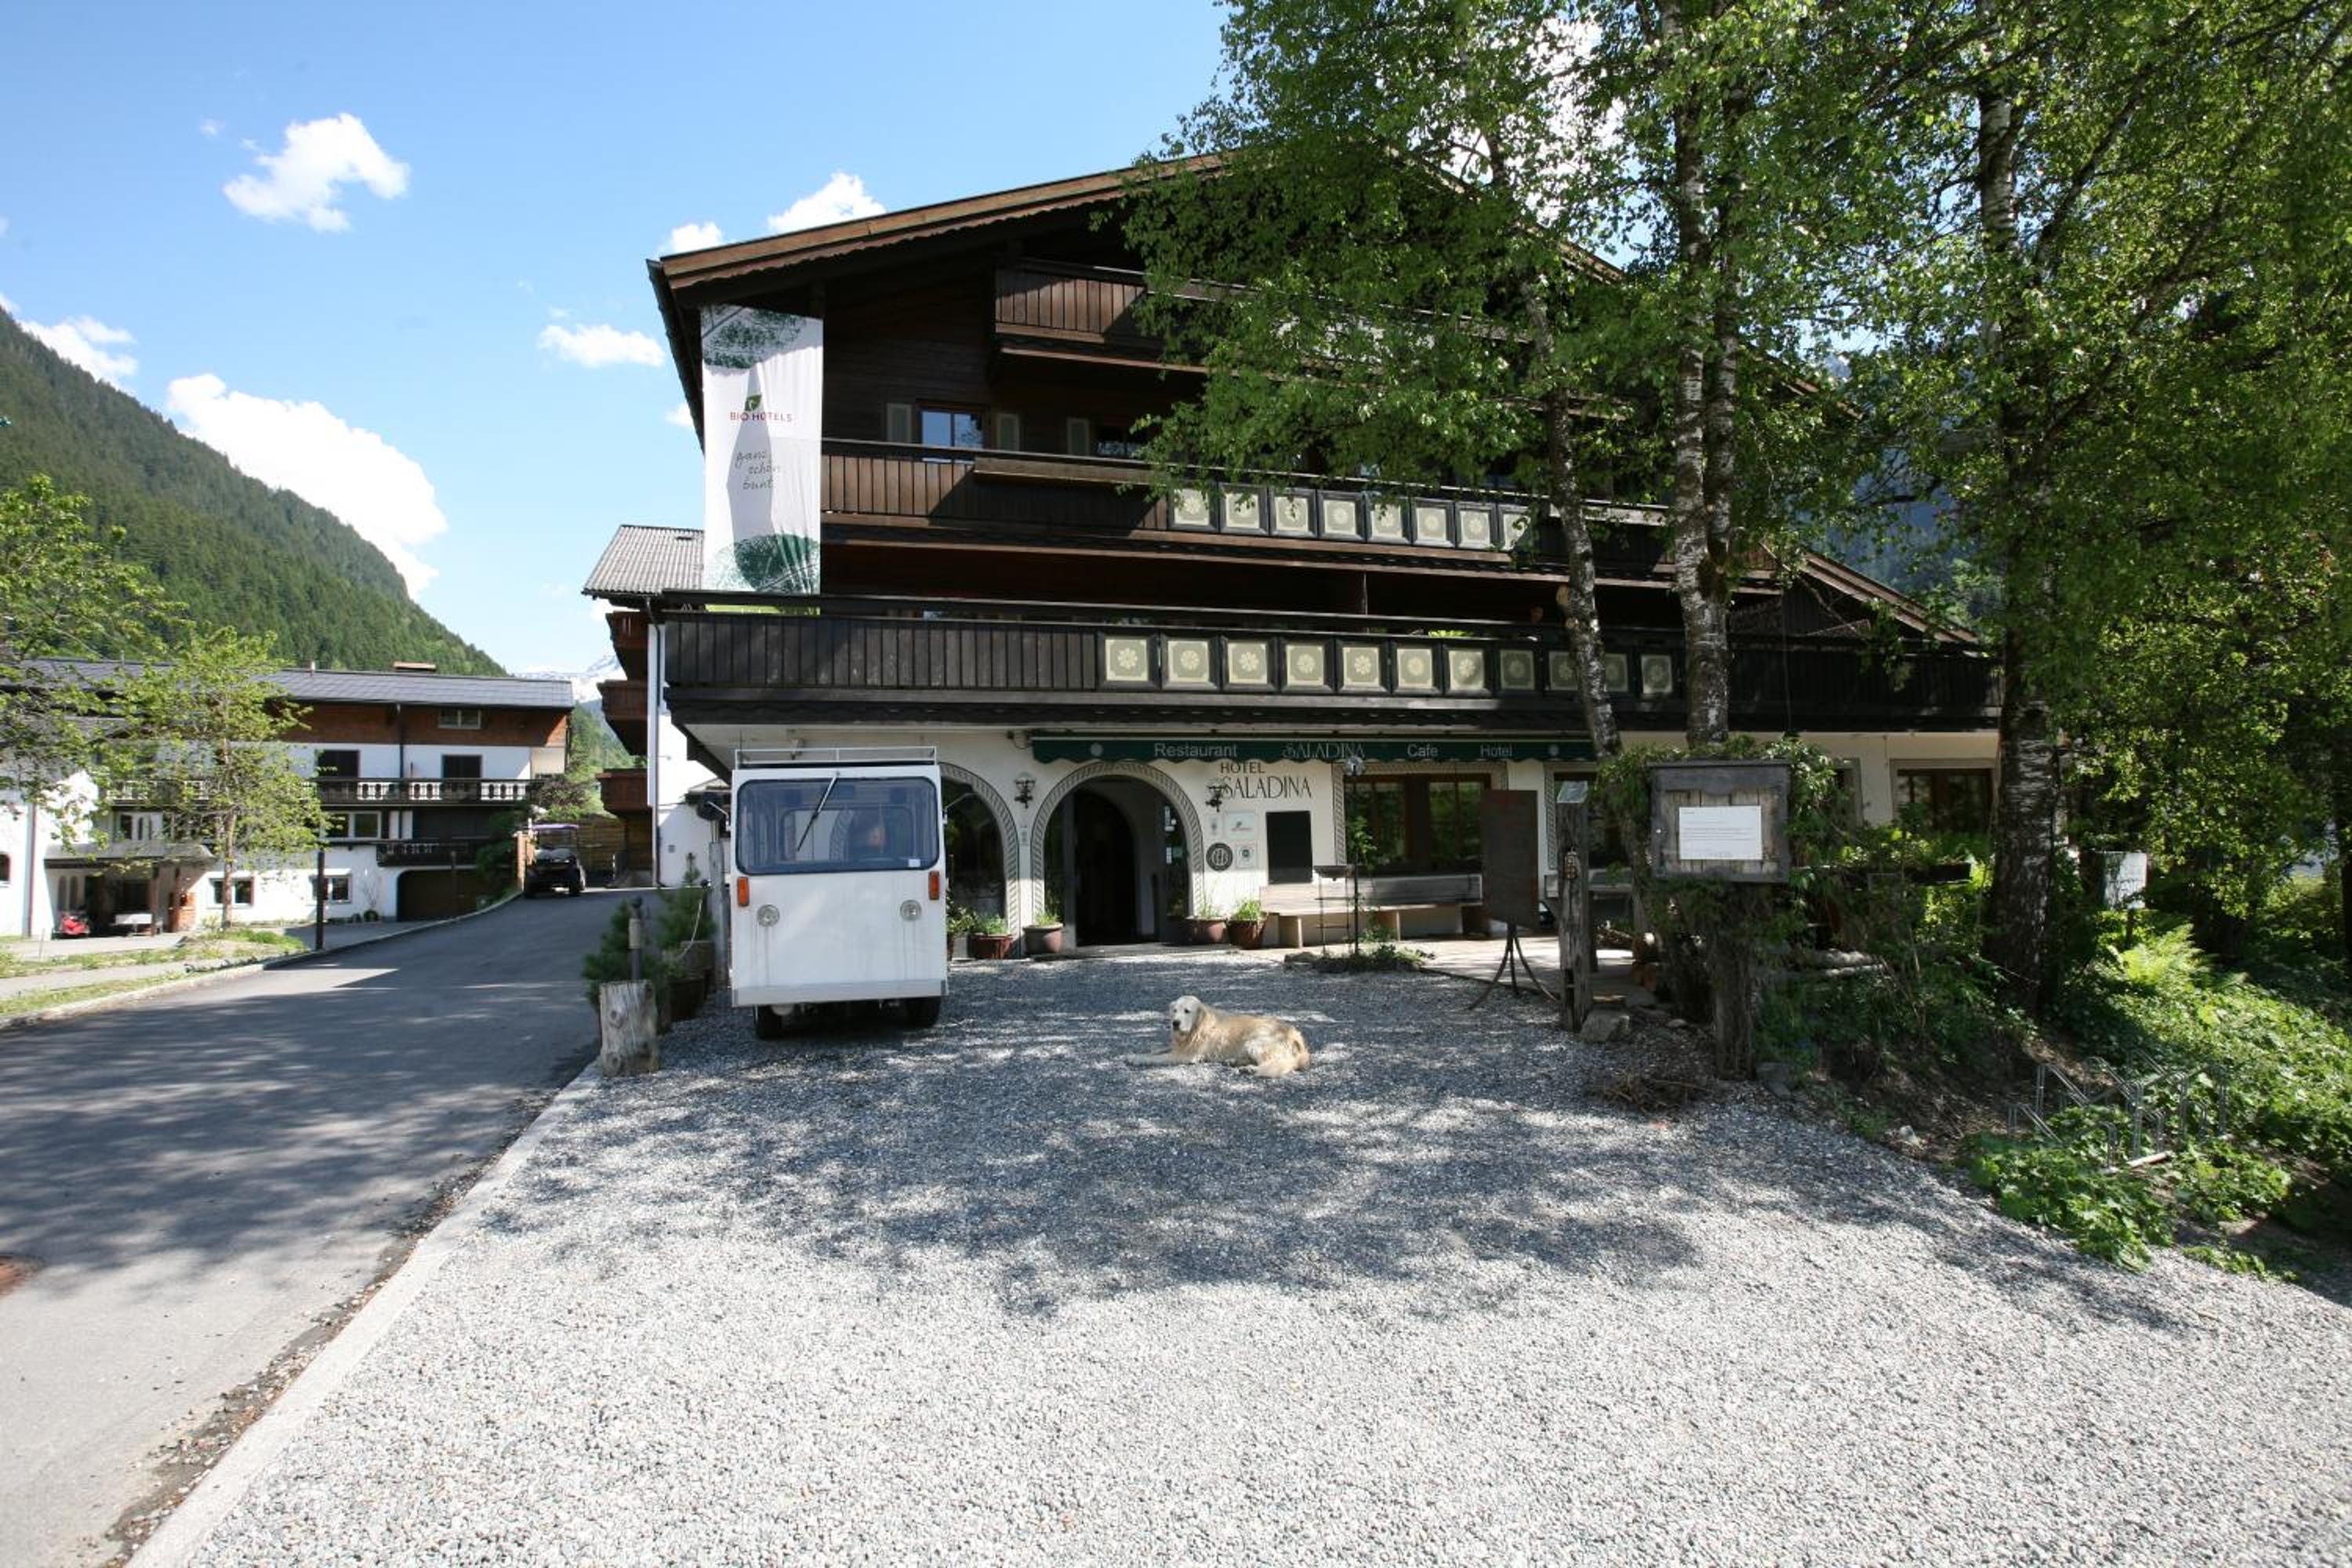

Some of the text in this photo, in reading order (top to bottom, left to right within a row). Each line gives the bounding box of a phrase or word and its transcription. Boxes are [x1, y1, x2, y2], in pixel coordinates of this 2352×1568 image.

[730, 412, 793, 423] BIO HOTELS
[1154, 742, 1512, 759] Restaurant SALADINA Cafe Hotel
[1220, 761, 1265, 774] HOTEL
[1221, 775, 1312, 799] SALADINA
